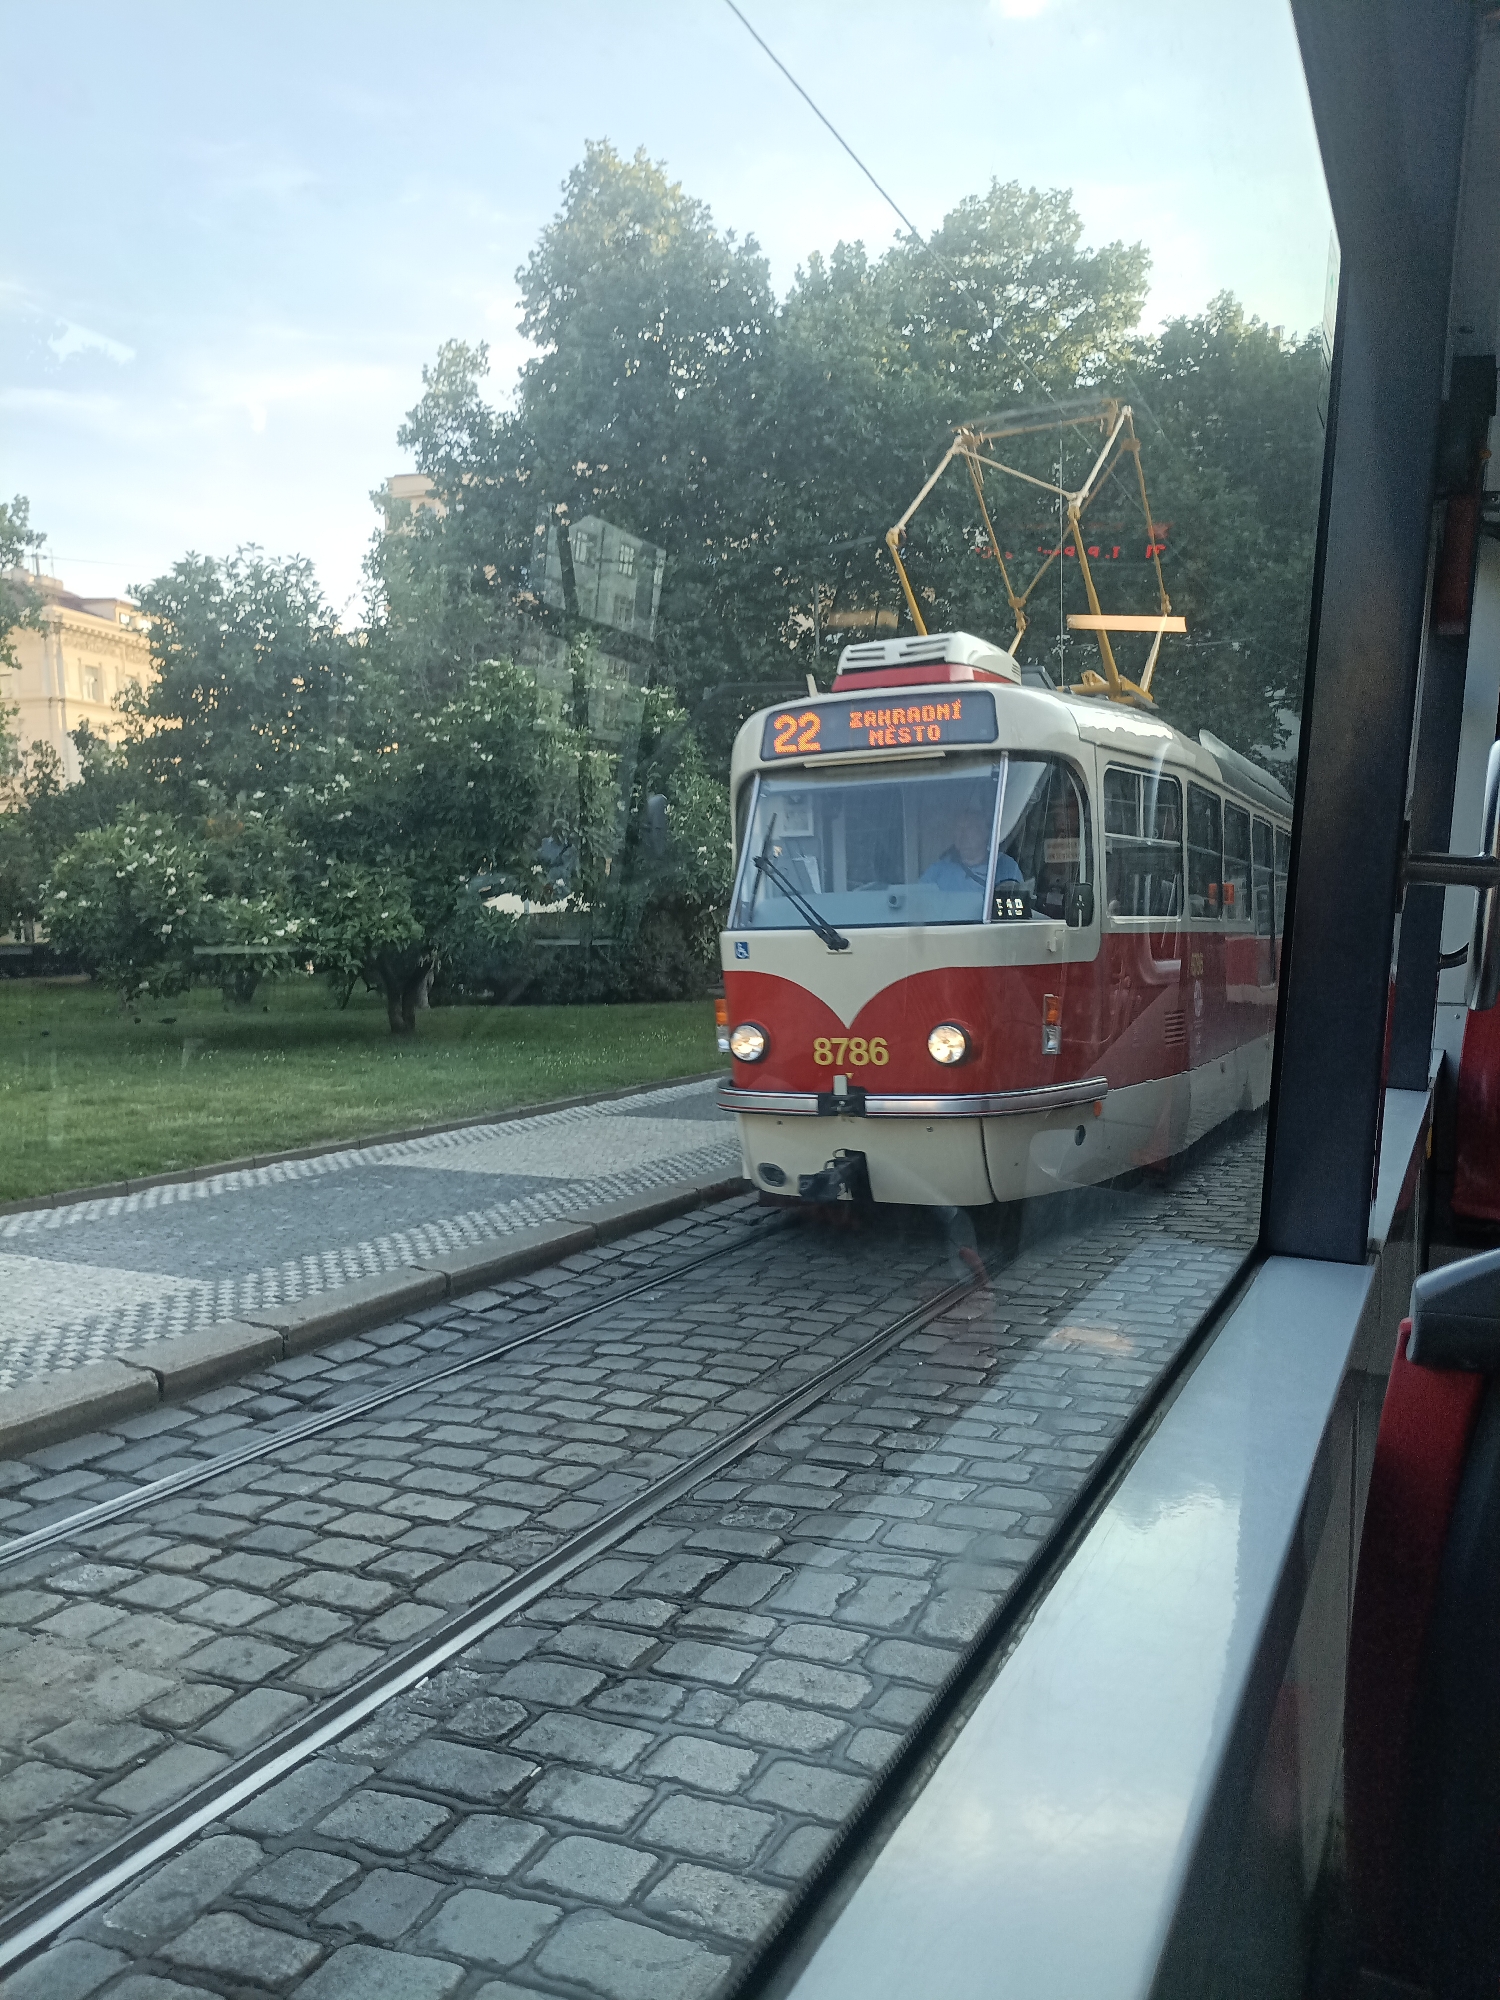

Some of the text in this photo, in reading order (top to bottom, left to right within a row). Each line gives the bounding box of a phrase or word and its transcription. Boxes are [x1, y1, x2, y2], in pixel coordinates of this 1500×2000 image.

[849, 700, 962, 729] ZAHRADNÍ
[773, 712, 821, 753] 22
[813, 1037, 889, 1066] 8786
